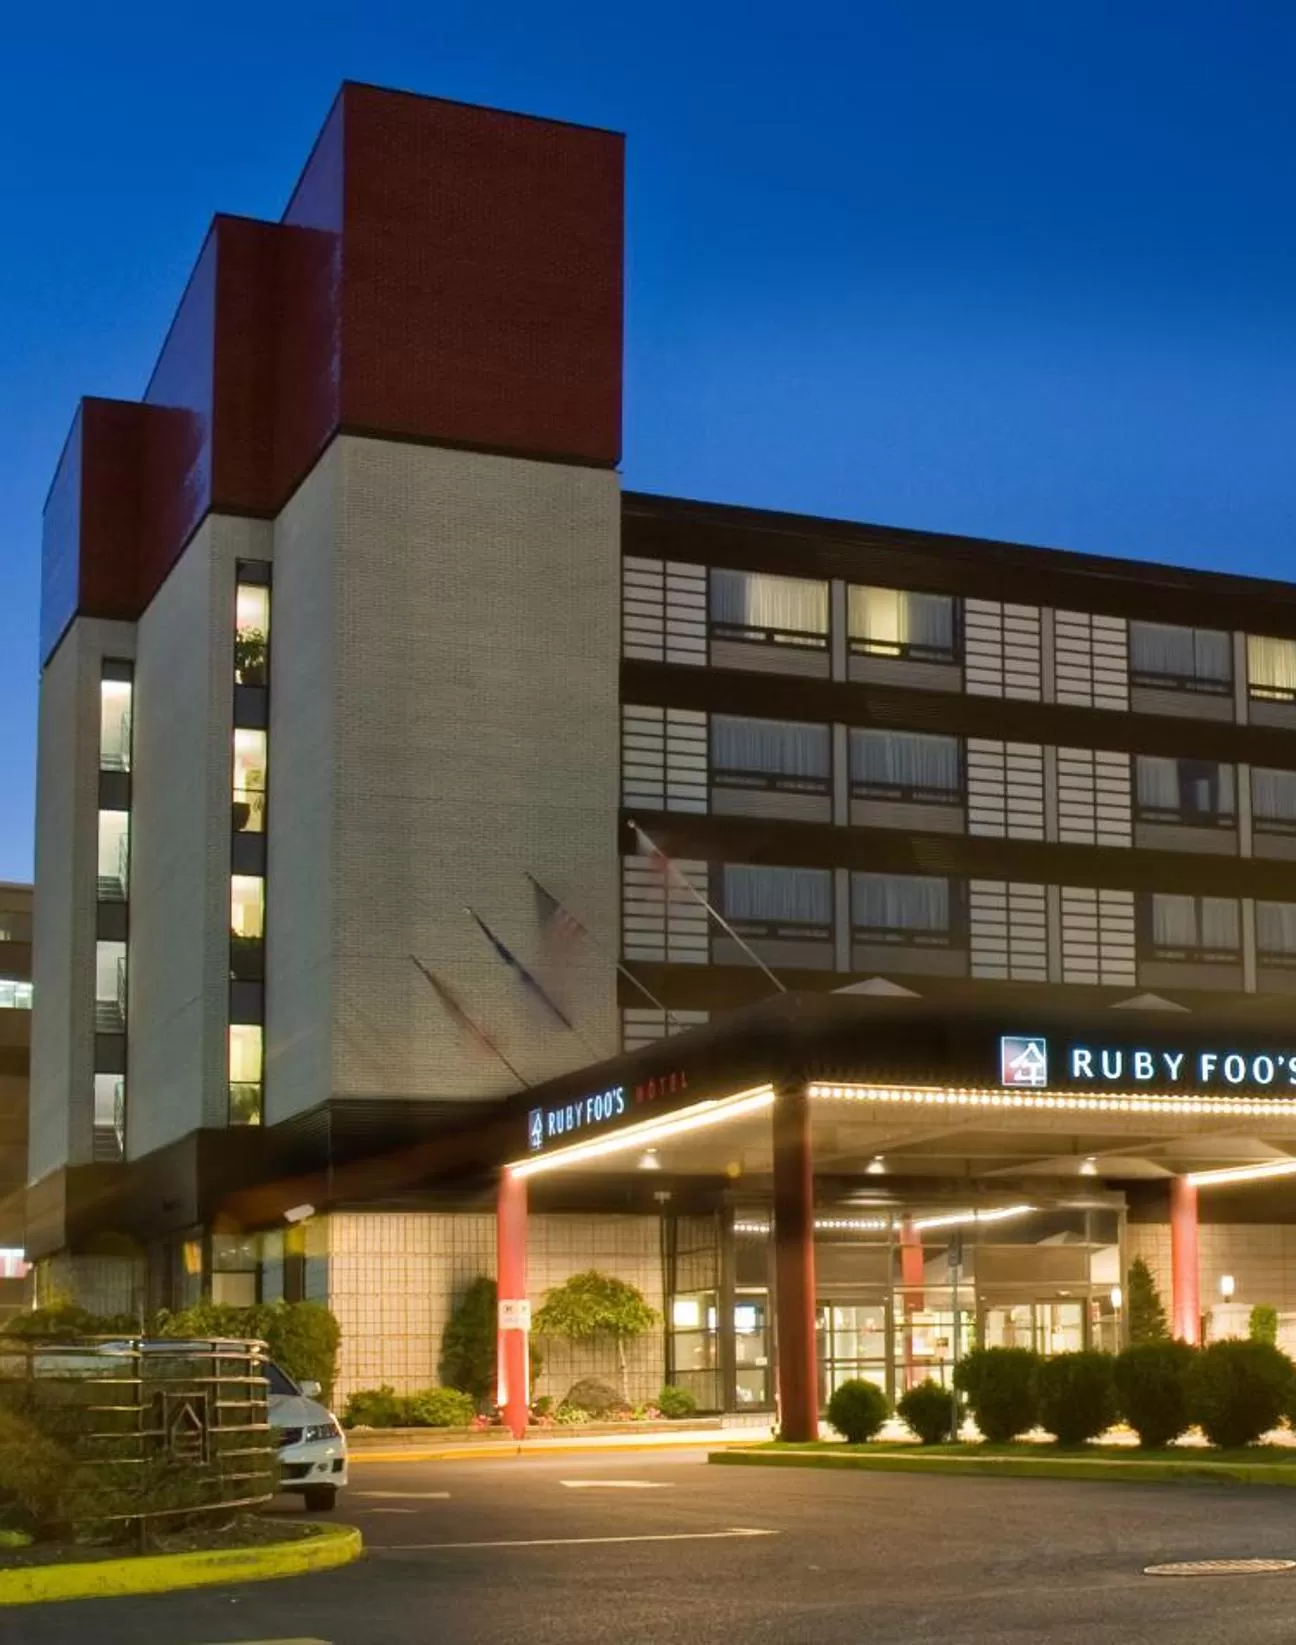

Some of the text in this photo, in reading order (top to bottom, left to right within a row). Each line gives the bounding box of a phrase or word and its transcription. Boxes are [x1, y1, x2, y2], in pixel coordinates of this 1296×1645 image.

[1072, 1049, 1184, 1082] RUBY
[547, 1101, 584, 1137] RUBY
[586, 1085, 625, 1125] FOO'S
